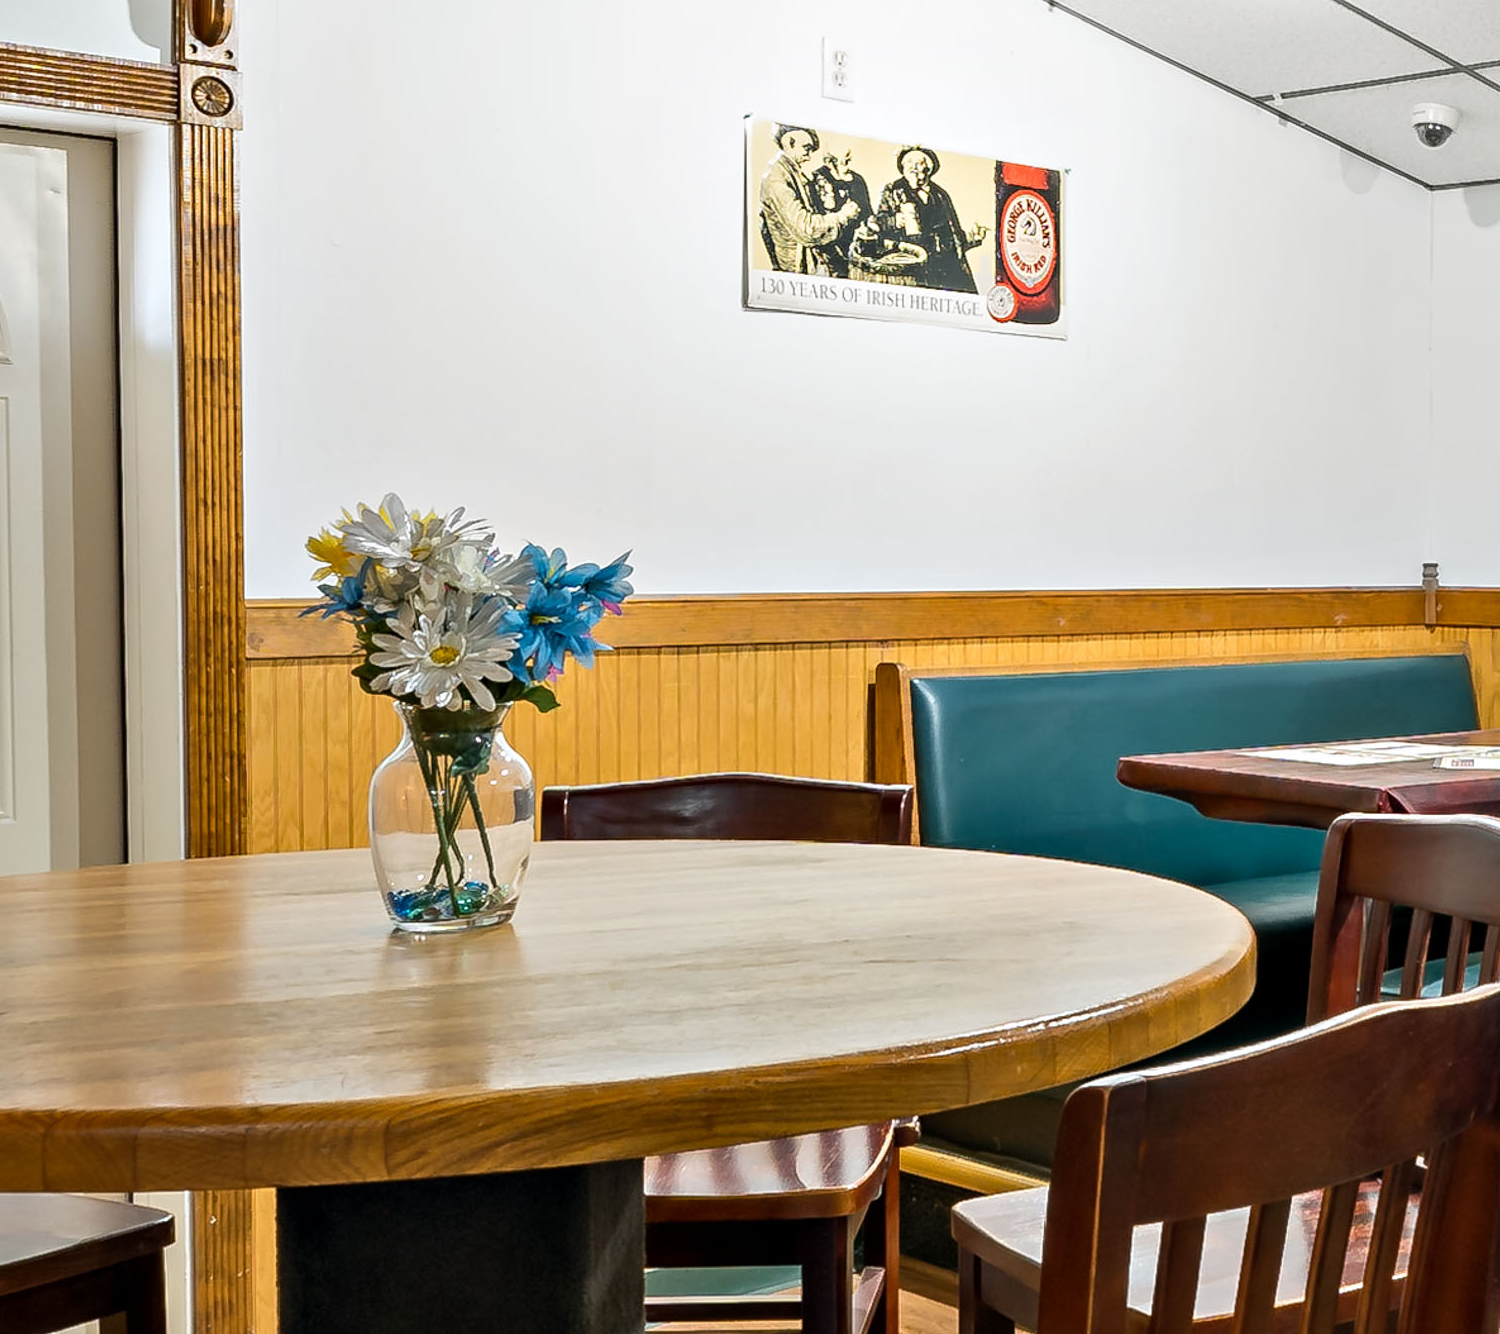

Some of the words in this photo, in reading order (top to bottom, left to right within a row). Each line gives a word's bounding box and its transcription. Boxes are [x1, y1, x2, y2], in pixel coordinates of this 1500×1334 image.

[1007, 201, 1025, 244] GEORGE
[1011, 251, 1032, 274] IRISH
[1034, 254, 1047, 273] RED
[760, 277, 785, 295] 130
[790, 281, 838, 300] YEARS
[842, 286, 862, 303] OF
[867, 290, 906, 309] IRISH
